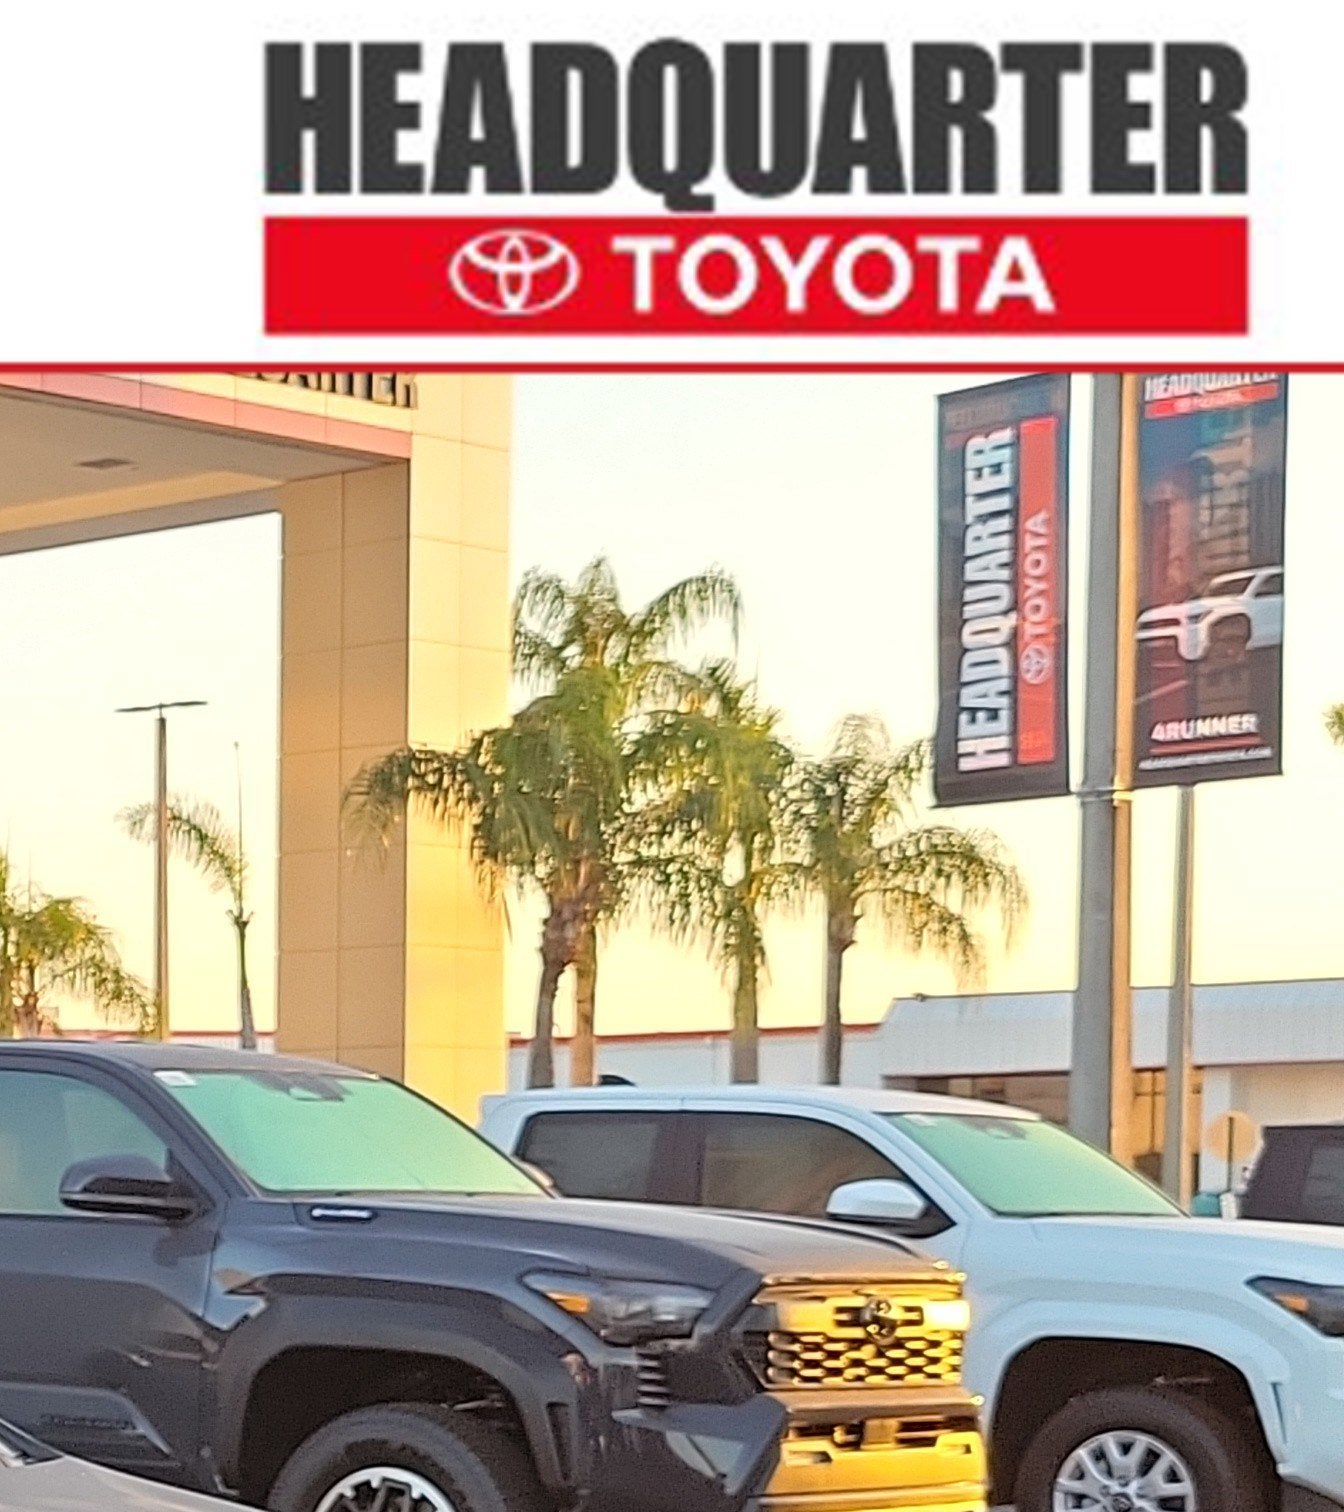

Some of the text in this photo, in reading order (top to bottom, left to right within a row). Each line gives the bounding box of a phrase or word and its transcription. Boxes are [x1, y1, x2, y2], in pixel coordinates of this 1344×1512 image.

[957, 426, 1017, 772] HEADQUARTER
[1023, 508, 1050, 641] TOYOTA
[1150, 712, 1259, 742] 4RUNNER
